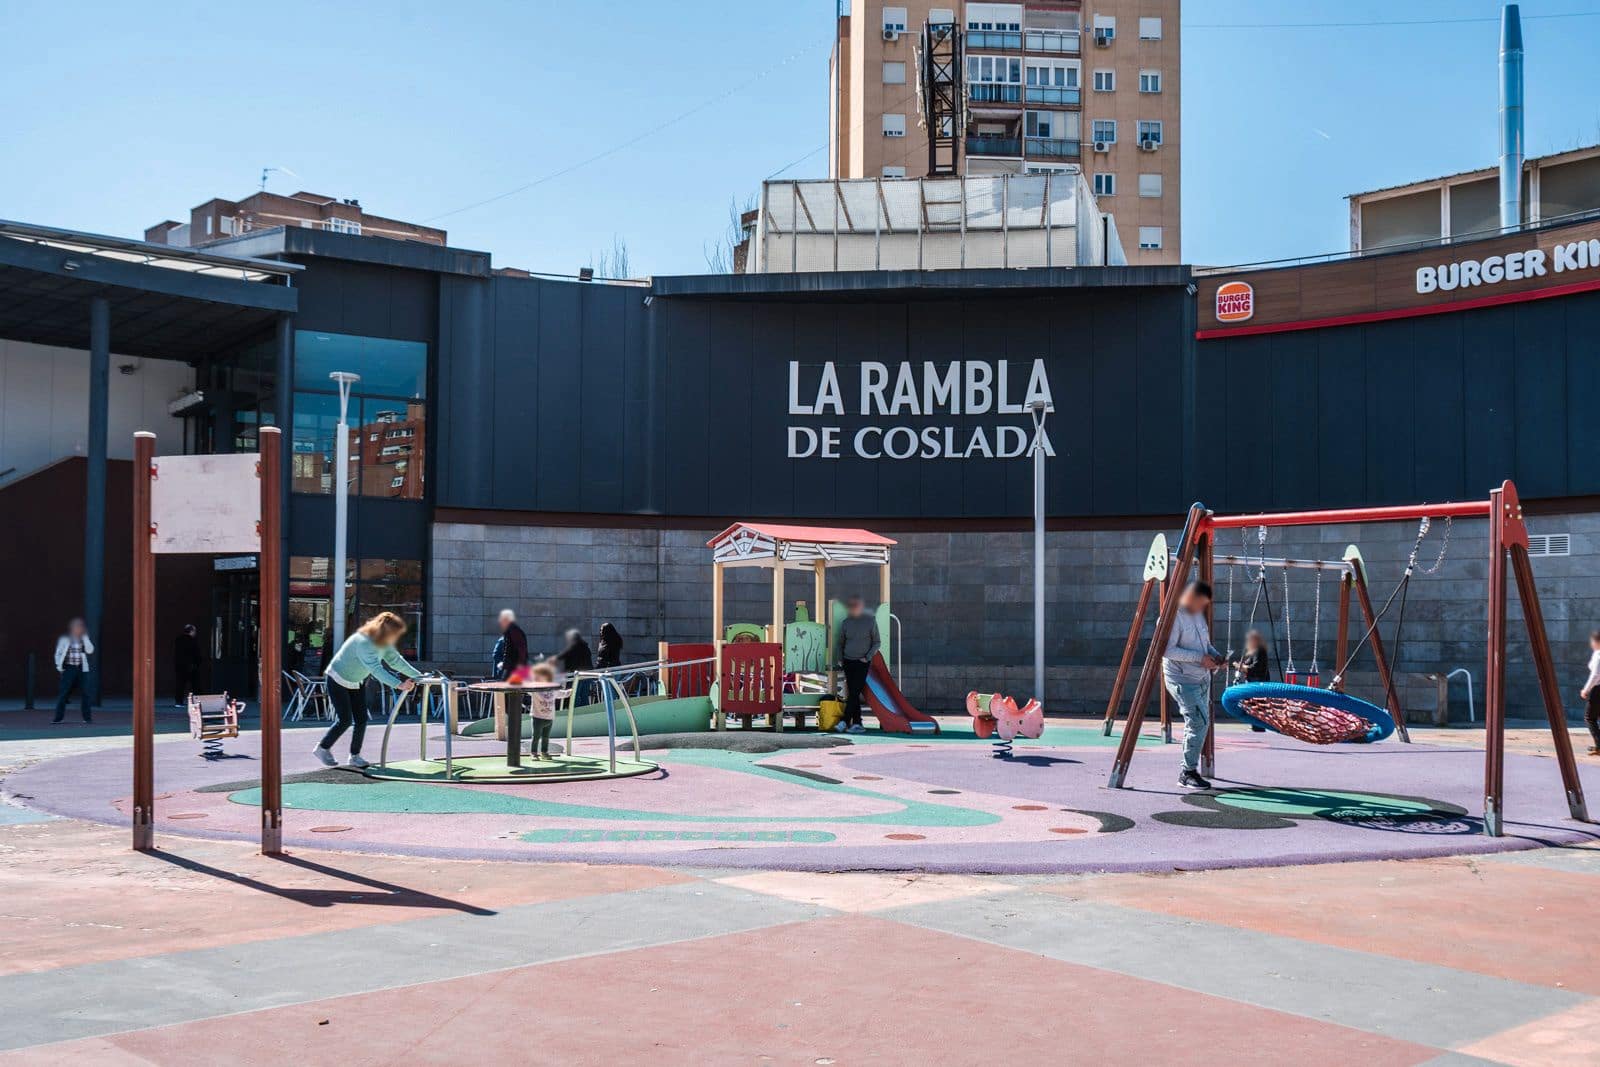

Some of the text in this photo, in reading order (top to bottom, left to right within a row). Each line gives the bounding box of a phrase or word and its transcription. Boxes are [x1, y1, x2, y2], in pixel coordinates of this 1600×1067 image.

[1416, 249, 1547, 294] BURGER
[1218, 293, 1250, 303] BURGER
[1218, 301, 1250, 313] KING
[788, 358, 1055, 416] LA RAMBLA
[787, 426, 1056, 459] DE COSLADA
